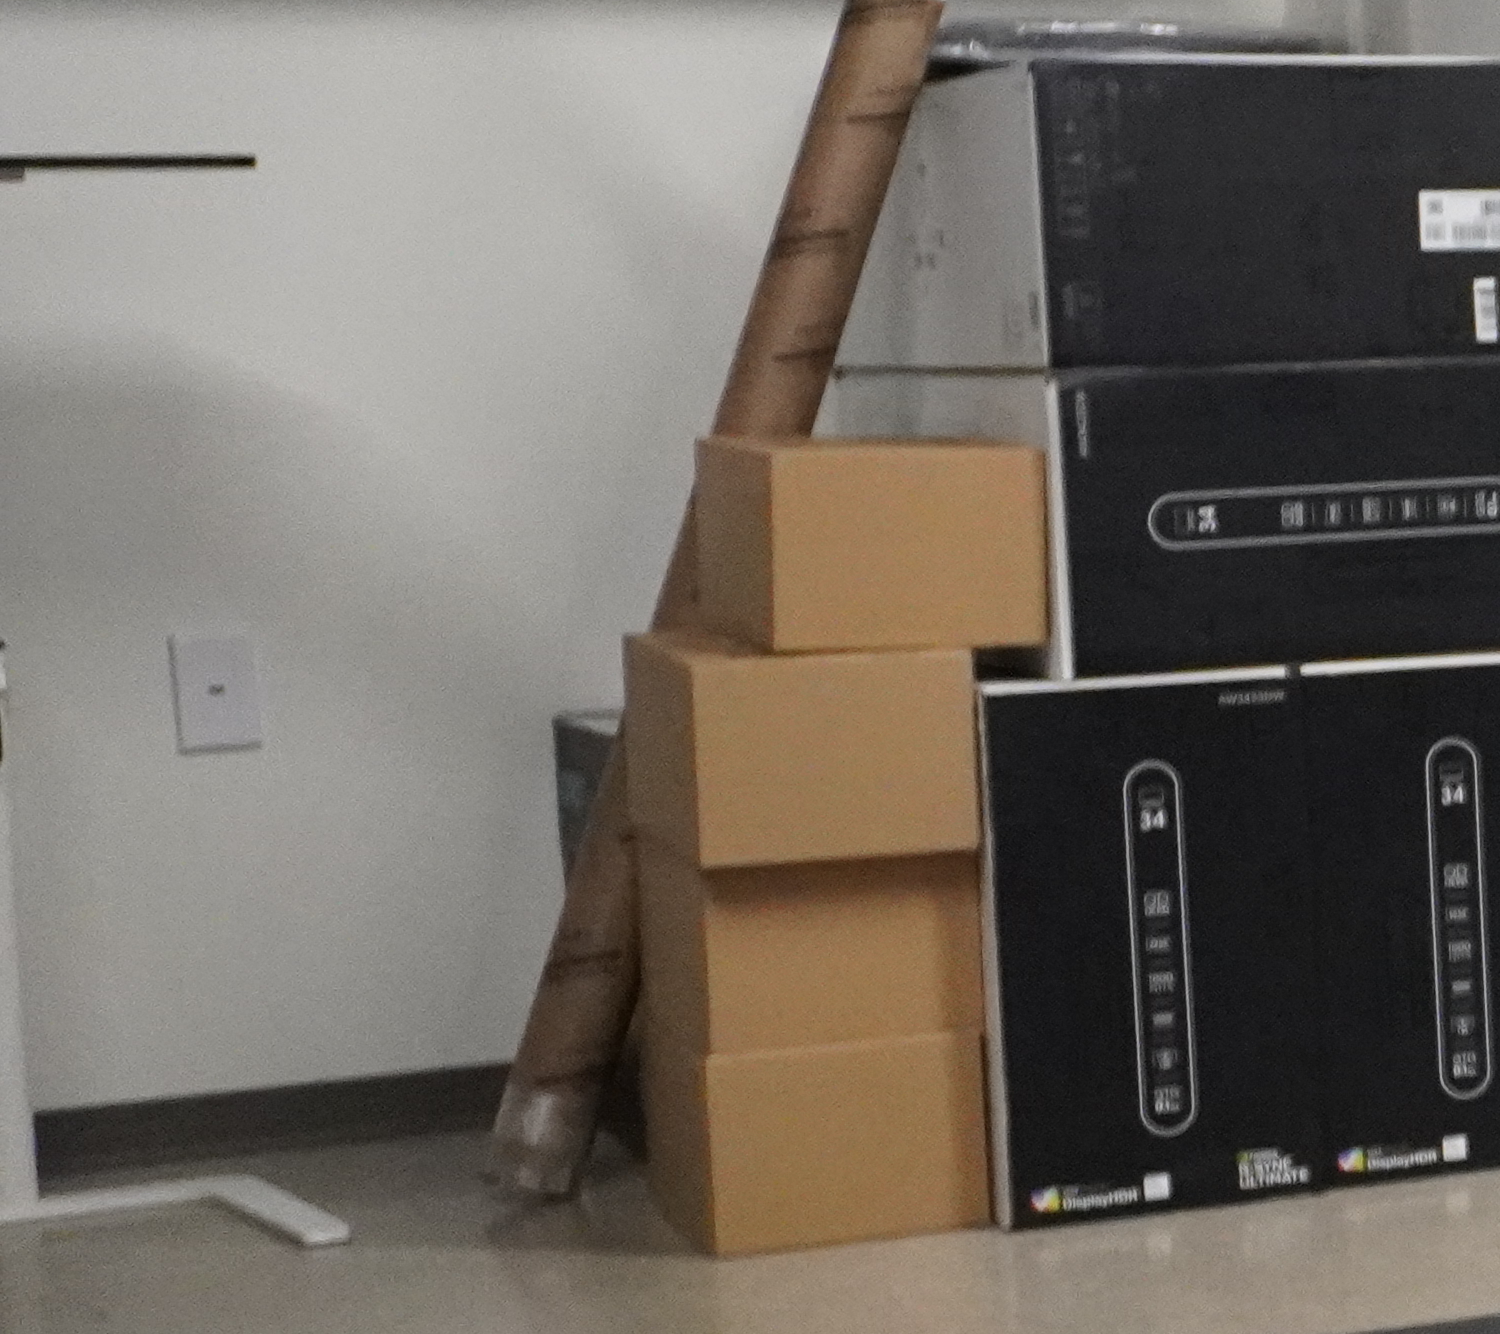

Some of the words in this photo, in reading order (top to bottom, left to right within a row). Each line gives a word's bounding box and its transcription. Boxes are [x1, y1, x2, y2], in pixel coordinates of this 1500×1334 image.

[1197, 504, 1219, 535] 34
[1441, 784, 1466, 807] 34
[1139, 809, 1168, 832] 34
